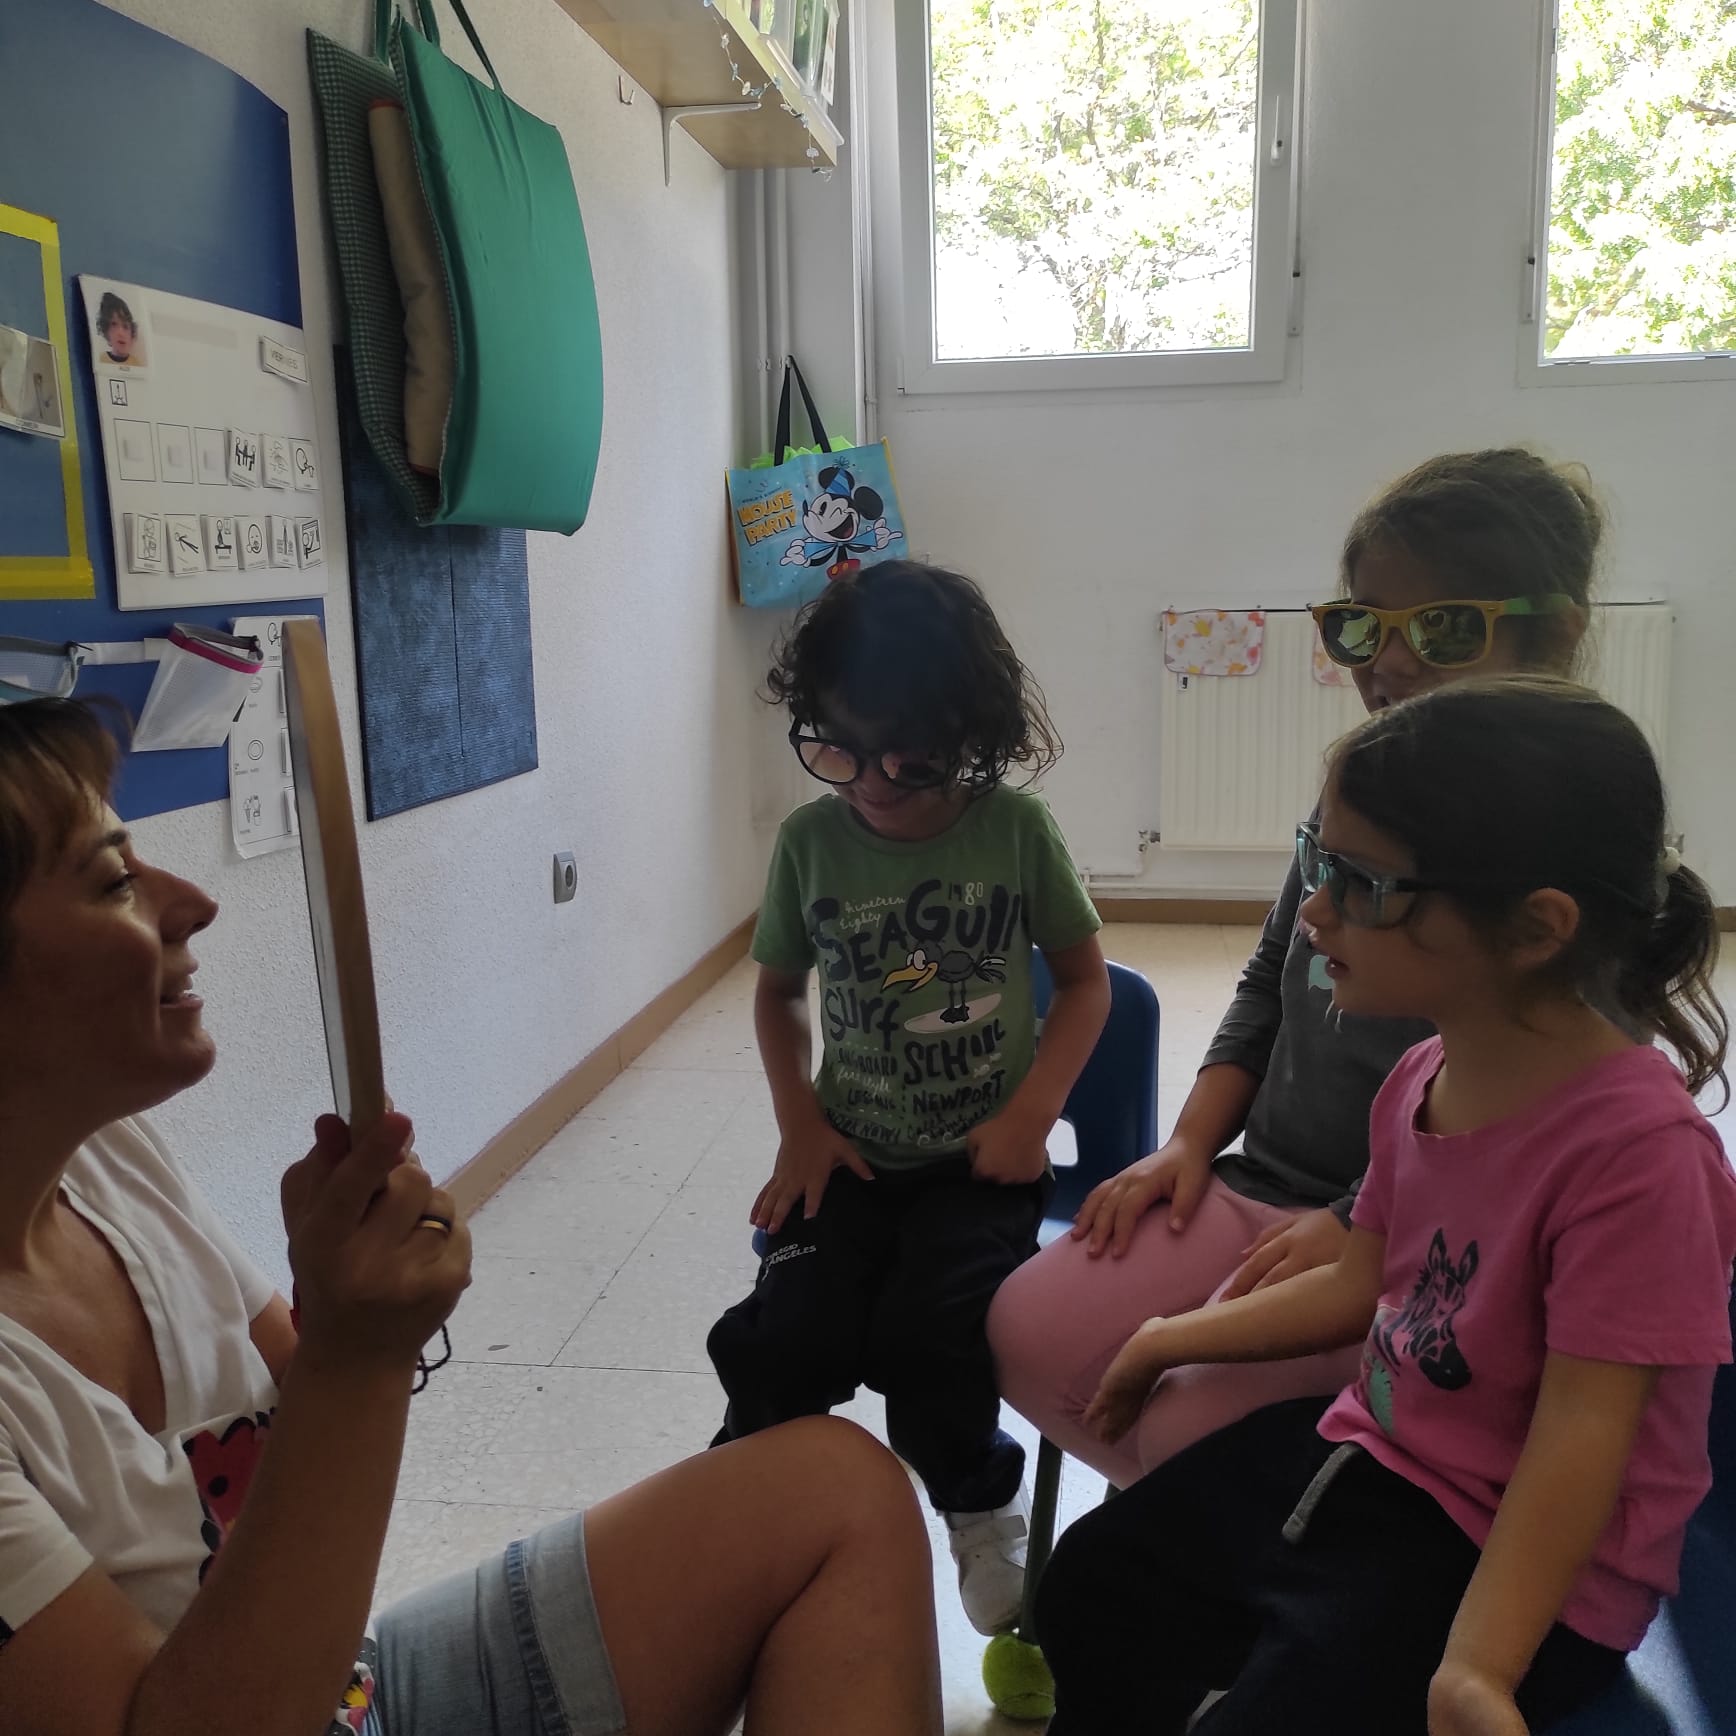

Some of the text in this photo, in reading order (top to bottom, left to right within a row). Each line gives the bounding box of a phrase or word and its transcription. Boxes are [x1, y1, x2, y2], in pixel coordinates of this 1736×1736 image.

[737, 489, 795, 527] MOUSE
[743, 509, 797, 546] PARTY
[912, 1069, 1006, 1114] NEWPORT
[769, 1245, 817, 1267] ANGELES
